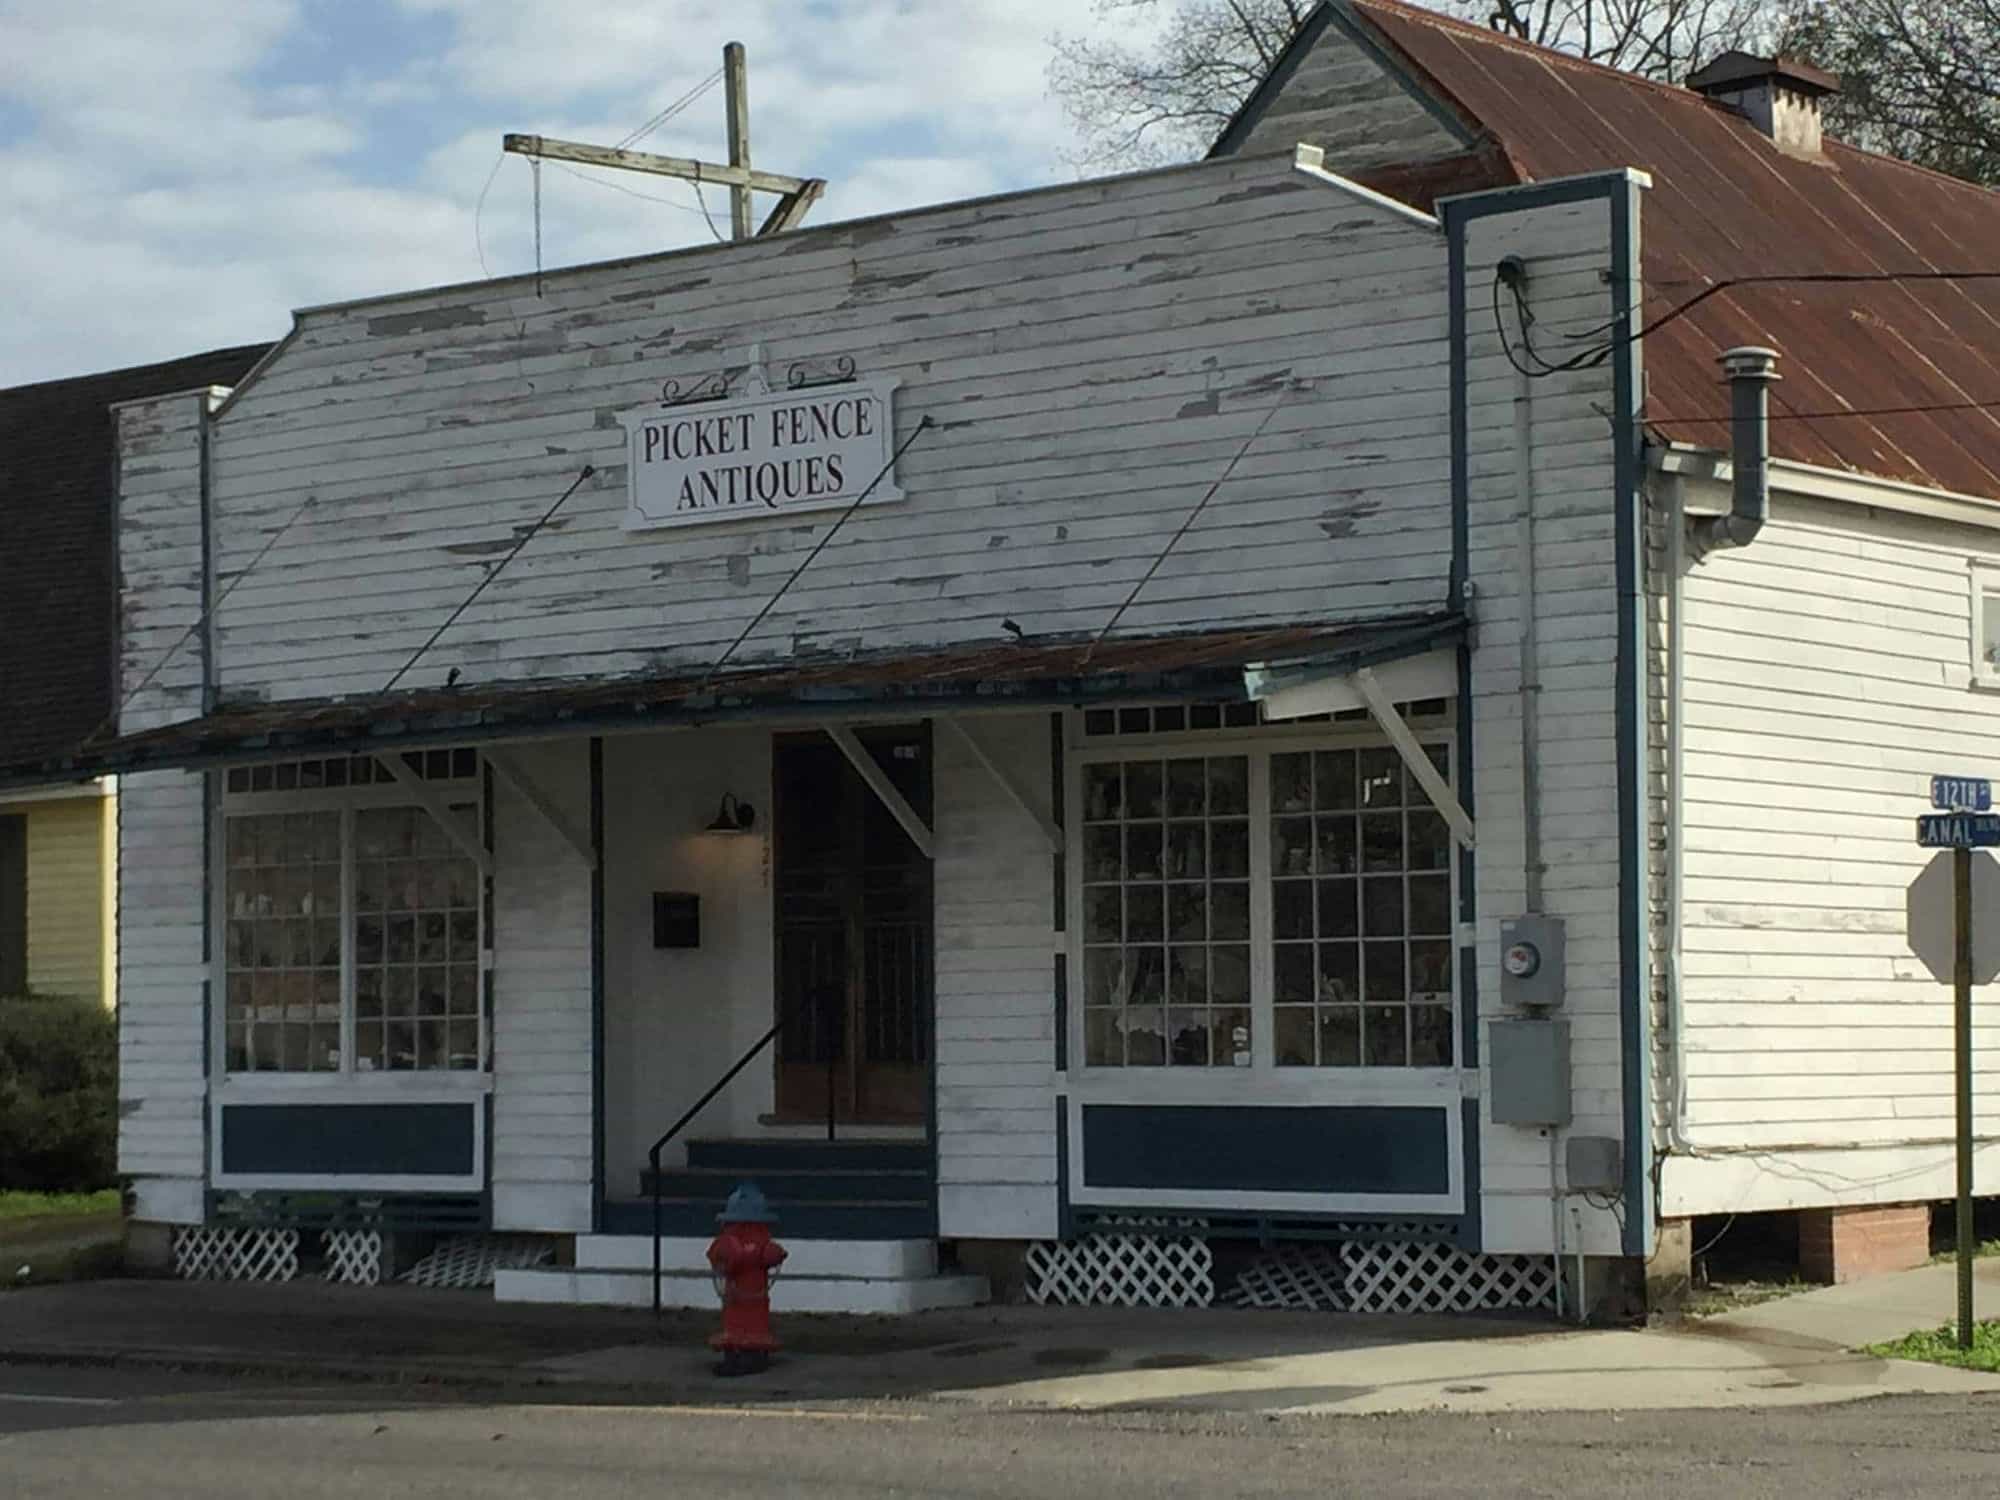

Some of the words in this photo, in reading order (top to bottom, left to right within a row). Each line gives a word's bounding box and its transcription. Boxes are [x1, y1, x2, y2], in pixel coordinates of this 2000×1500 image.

[644, 413, 755, 463] PICKET
[771, 397, 874, 448] FENCE
[677, 454, 844, 508] ANTIQUES
[1943, 781, 1977, 807] 12TH
[1919, 819, 1973, 844] CANAL
